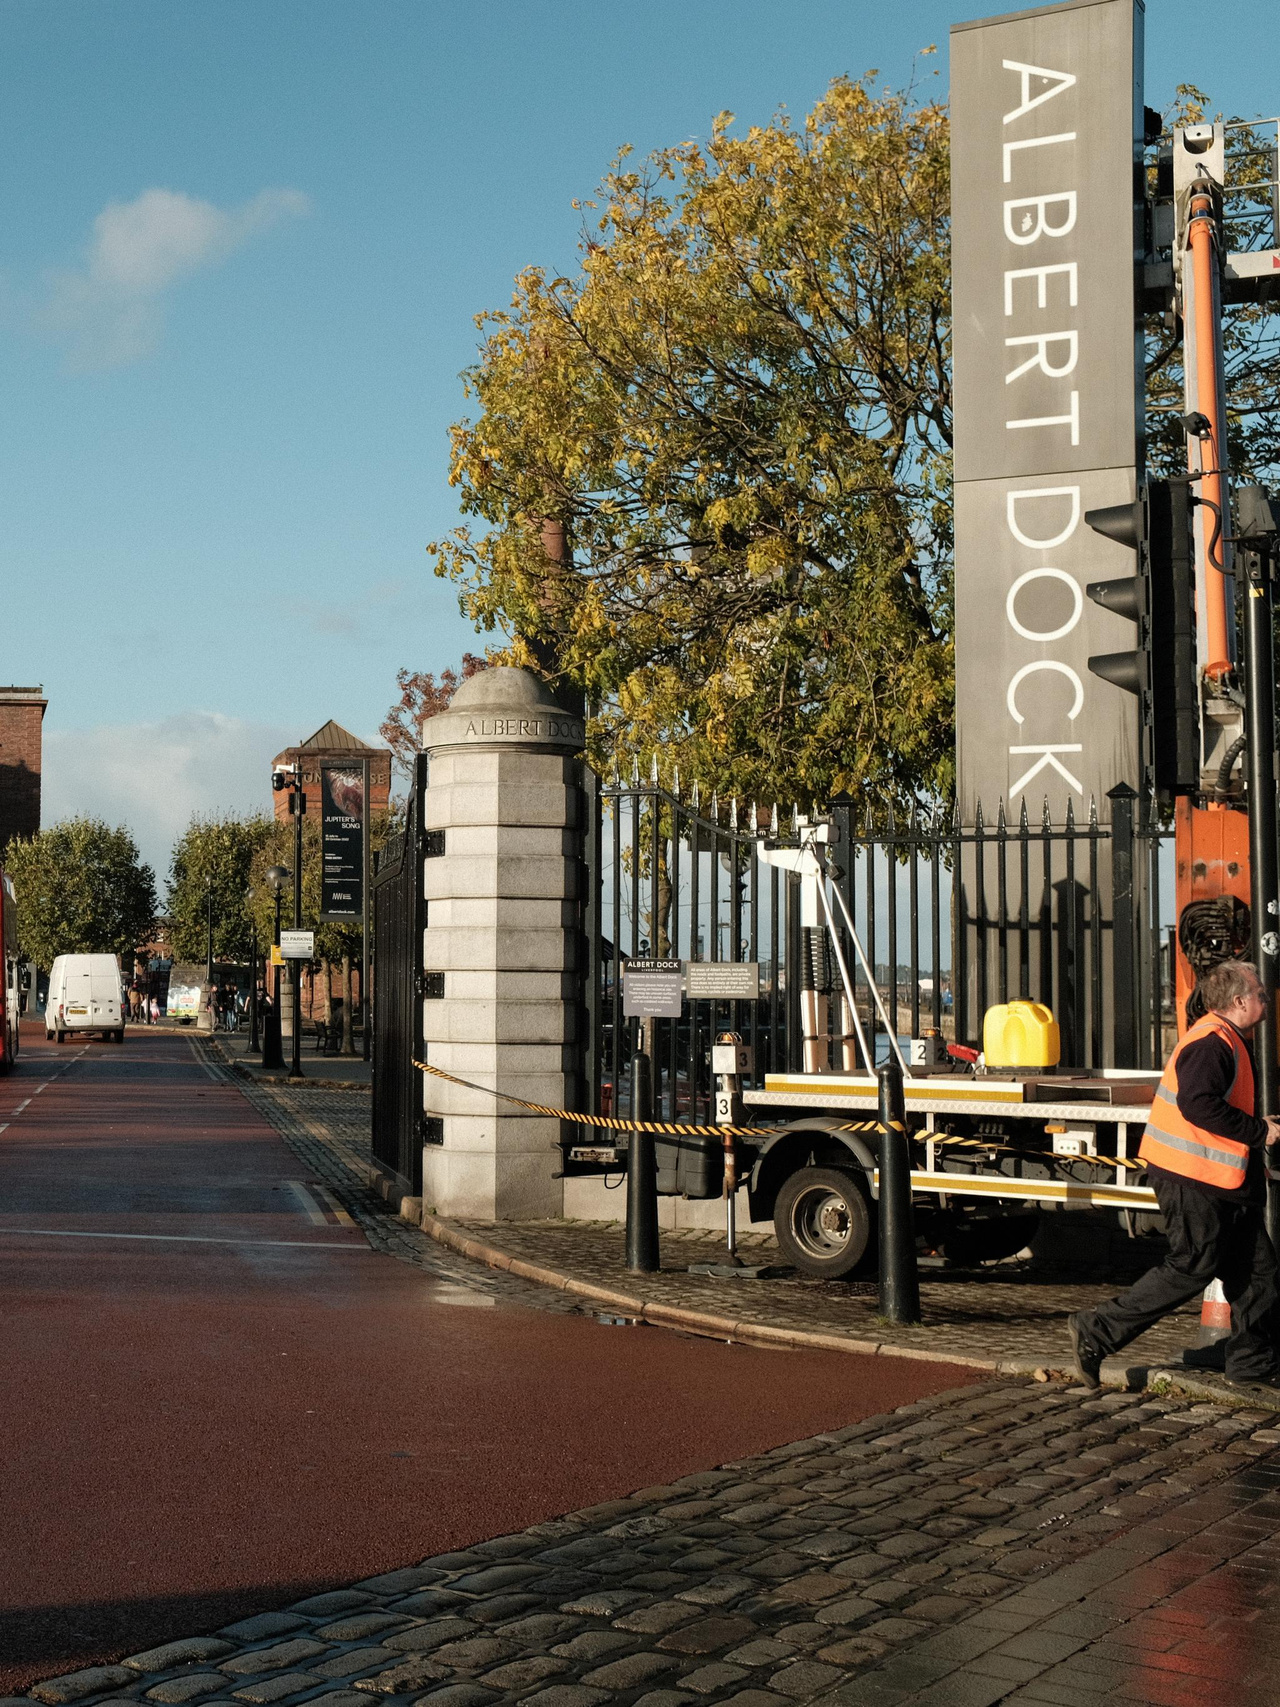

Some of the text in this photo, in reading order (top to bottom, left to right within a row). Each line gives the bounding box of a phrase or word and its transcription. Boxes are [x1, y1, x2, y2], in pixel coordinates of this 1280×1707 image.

[1002, 59, 1084, 797] ALBERT DOCK
[465, 720, 542, 736] ALBERT
[739, 1052, 748, 1067] 3
[918, 1045, 926, 1060] 2
[720, 1099, 729, 1115] 3
